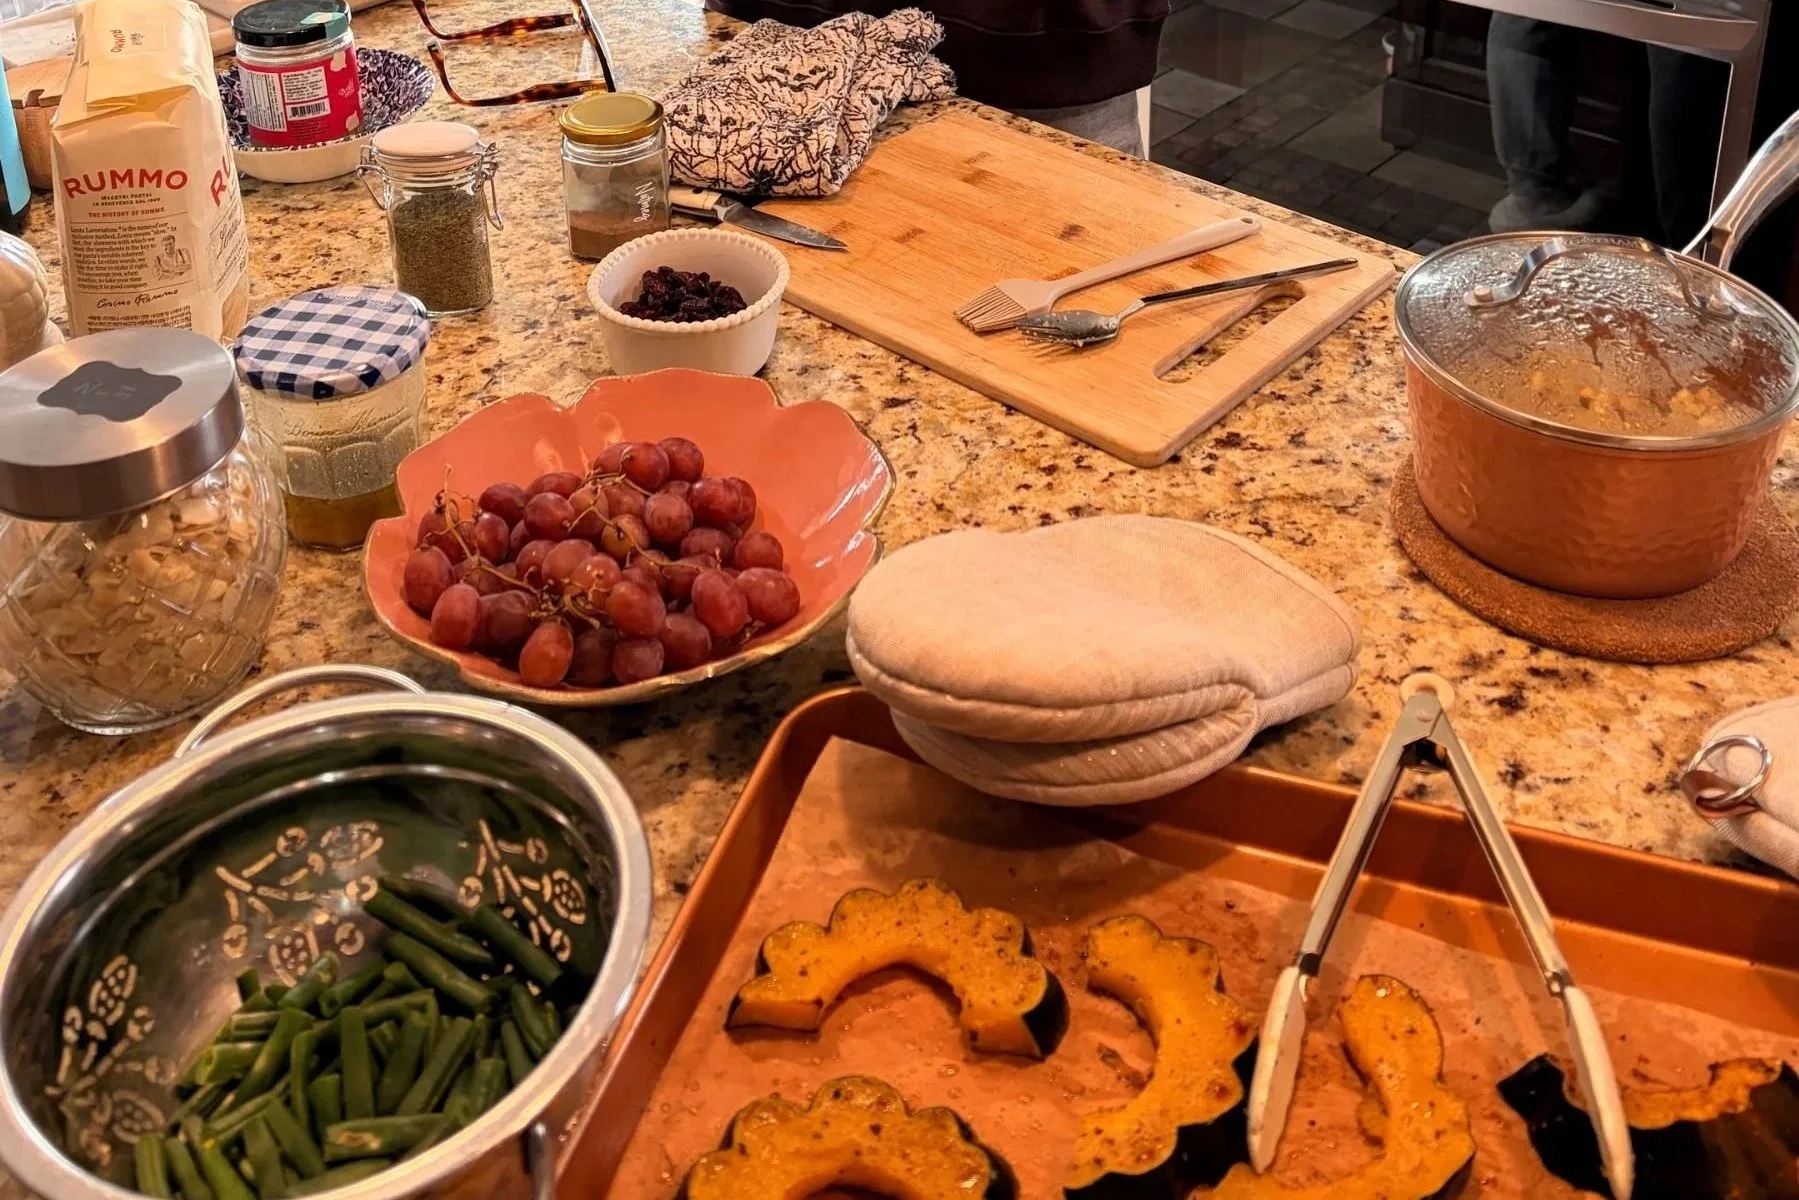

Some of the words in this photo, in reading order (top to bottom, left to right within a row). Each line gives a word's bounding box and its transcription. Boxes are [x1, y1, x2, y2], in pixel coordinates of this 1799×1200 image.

[110, 29, 125, 52] RUMMO
[63, 168, 188, 199] RUMMO
[141, 207, 165, 215] RUMMO
[633, 181, 656, 223] Nutmeg
